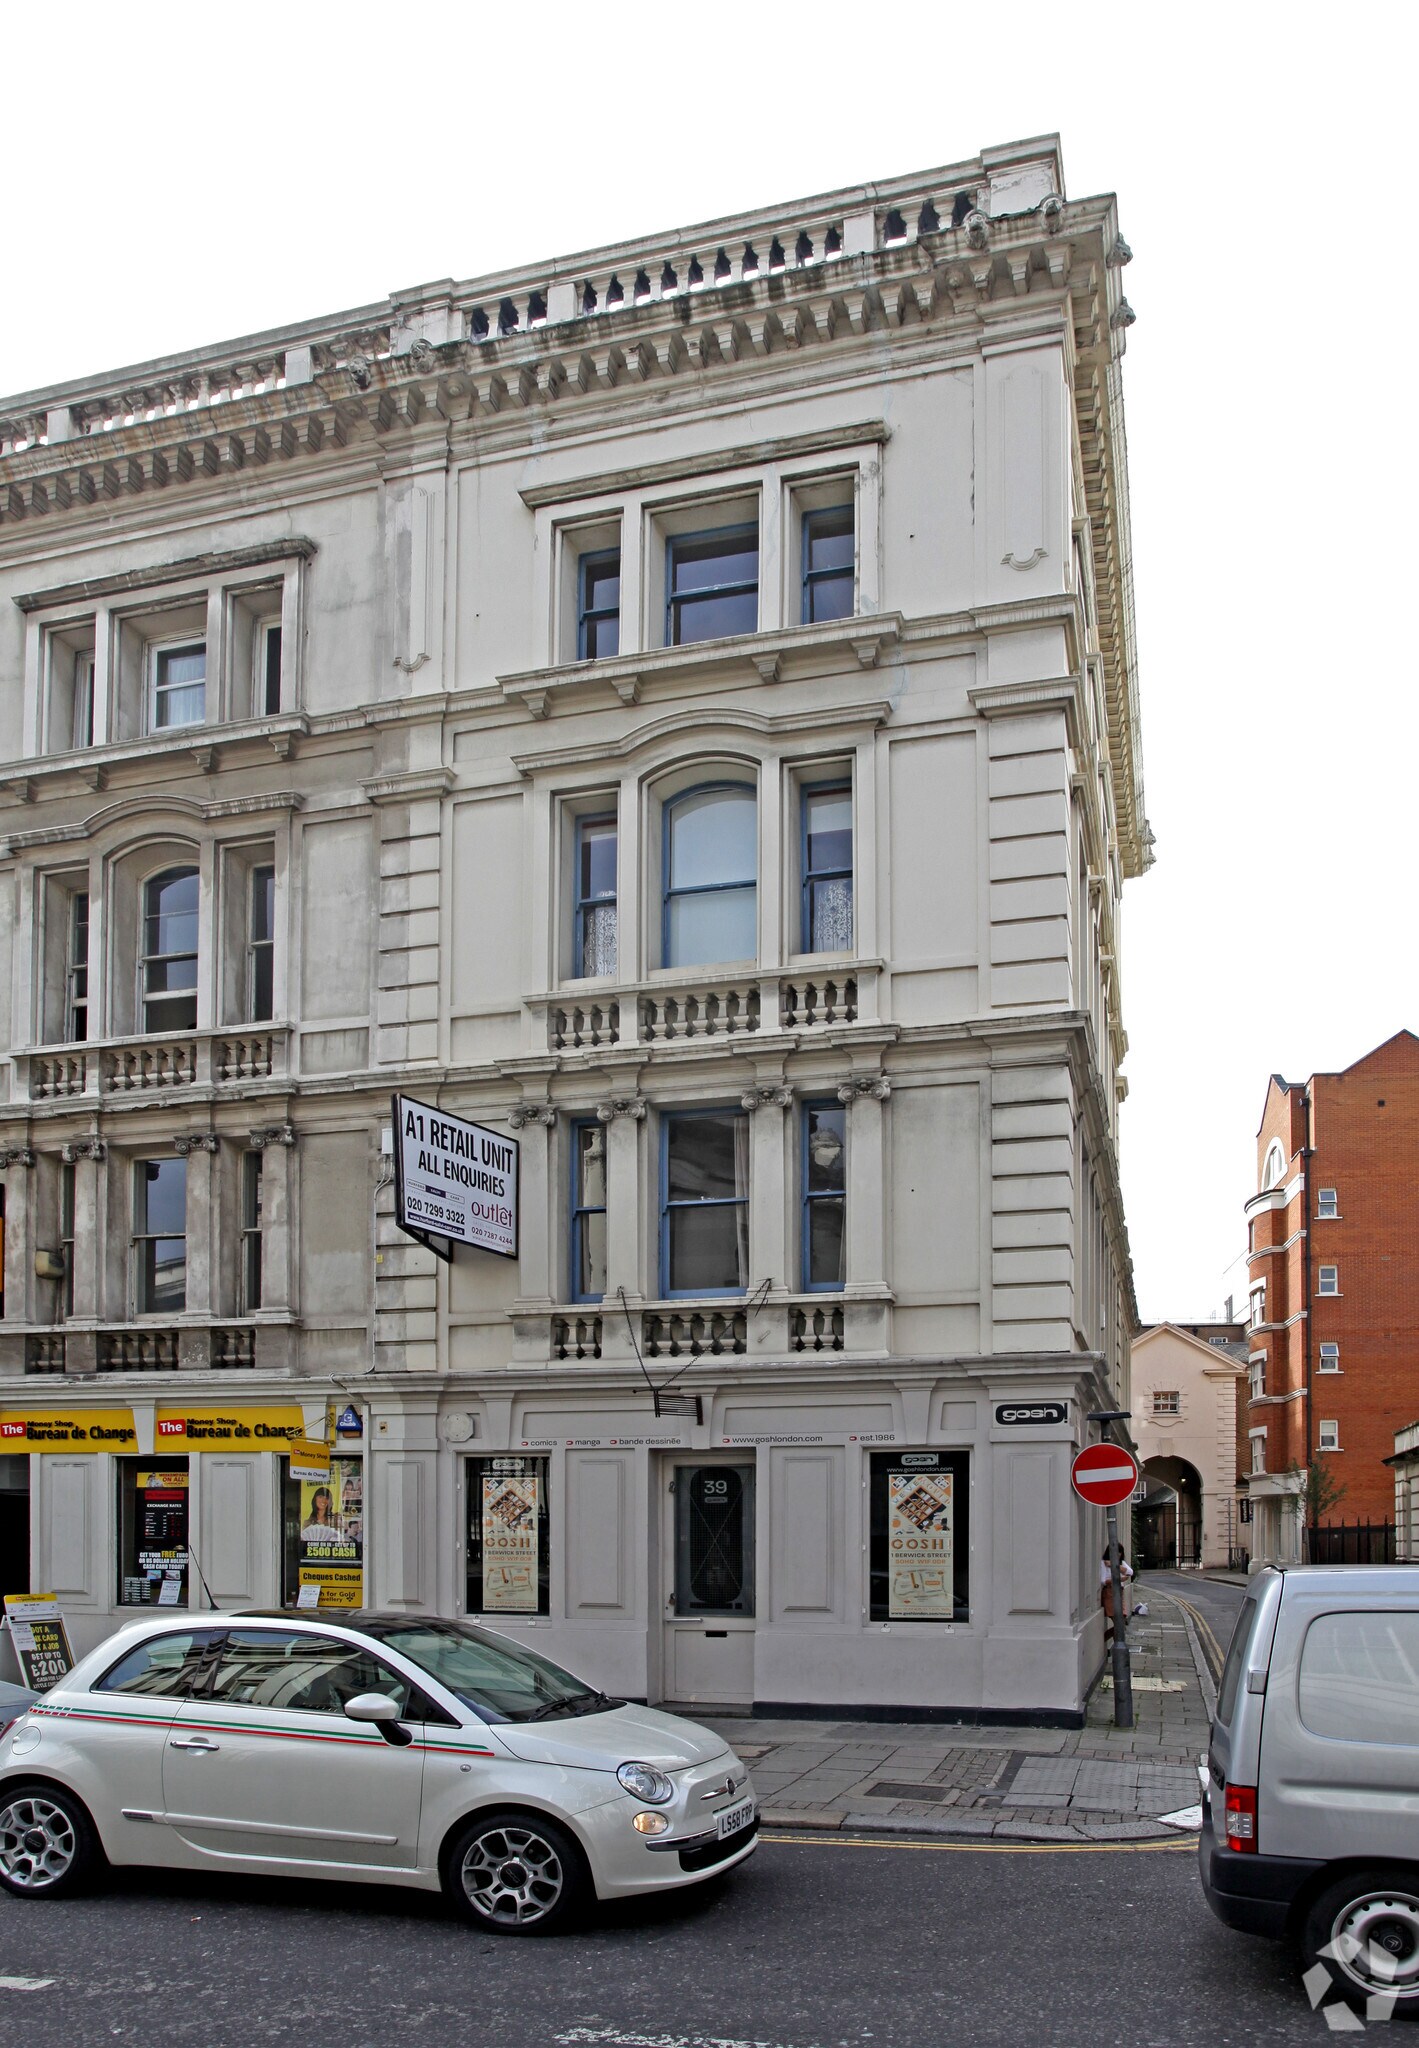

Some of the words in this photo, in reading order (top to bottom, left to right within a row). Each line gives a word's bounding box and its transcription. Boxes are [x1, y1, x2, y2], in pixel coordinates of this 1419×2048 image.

[406, 1110, 424, 1142] A1
[430, 1118, 478, 1162] RETAIL
[481, 1138, 513, 1174] UNIT
[418, 1150, 440, 1176] ALL
[444, 1158, 505, 1197] ENQUIRIES
[407, 1196, 422, 1211] 020
[424, 1202, 444, 1218] 7299
[446, 1209, 465, 1225] 3322
[472, 1226, 482, 1236] 020
[484, 1230, 498, 1240] 7287
[499, 1236, 512, 1245] 4244
[2, 1425, 23, 1435] The
[27, 1428, 68, 1440] Bureau
[71, 1426, 86, 1439] de
[90, 1426, 134, 1442] Change
[160, 1422, 183, 1433] The
[186, 1425, 232, 1438] Bureau
[234, 1424, 250, 1437] de
[732, 1435, 822, 1444] www.goshlondon.com
[300, 1450, 316, 1459] Money
[704, 1480, 728, 1494] 39
[306, 1547, 331, 1557] £500
[332, 1547, 356, 1557] CASH
[303, 1572, 333, 1581] Cheques
[334, 1573, 360, 1582] Cashed
[31, 1652, 44, 1660] GET
[31, 1659, 67, 1677] £200
[722, 1811, 740, 1834] LS58
